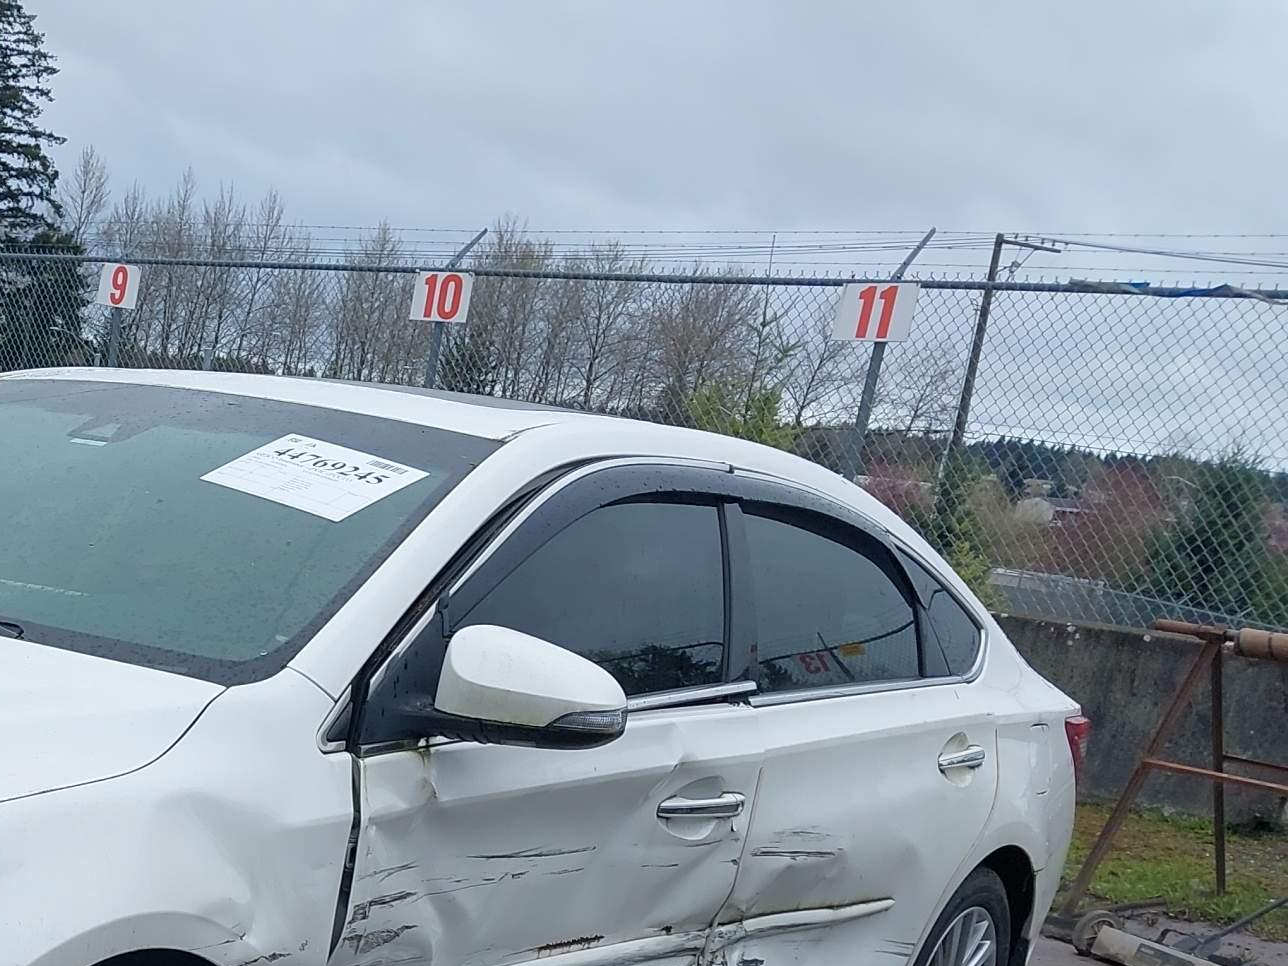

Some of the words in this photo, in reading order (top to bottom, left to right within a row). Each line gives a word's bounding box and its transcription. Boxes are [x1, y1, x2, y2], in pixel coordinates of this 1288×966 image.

[109, 264, 128, 306] 9
[423, 273, 463, 320] 10
[855, 285, 899, 339] 11
[273, 447, 391, 486] 44769245
